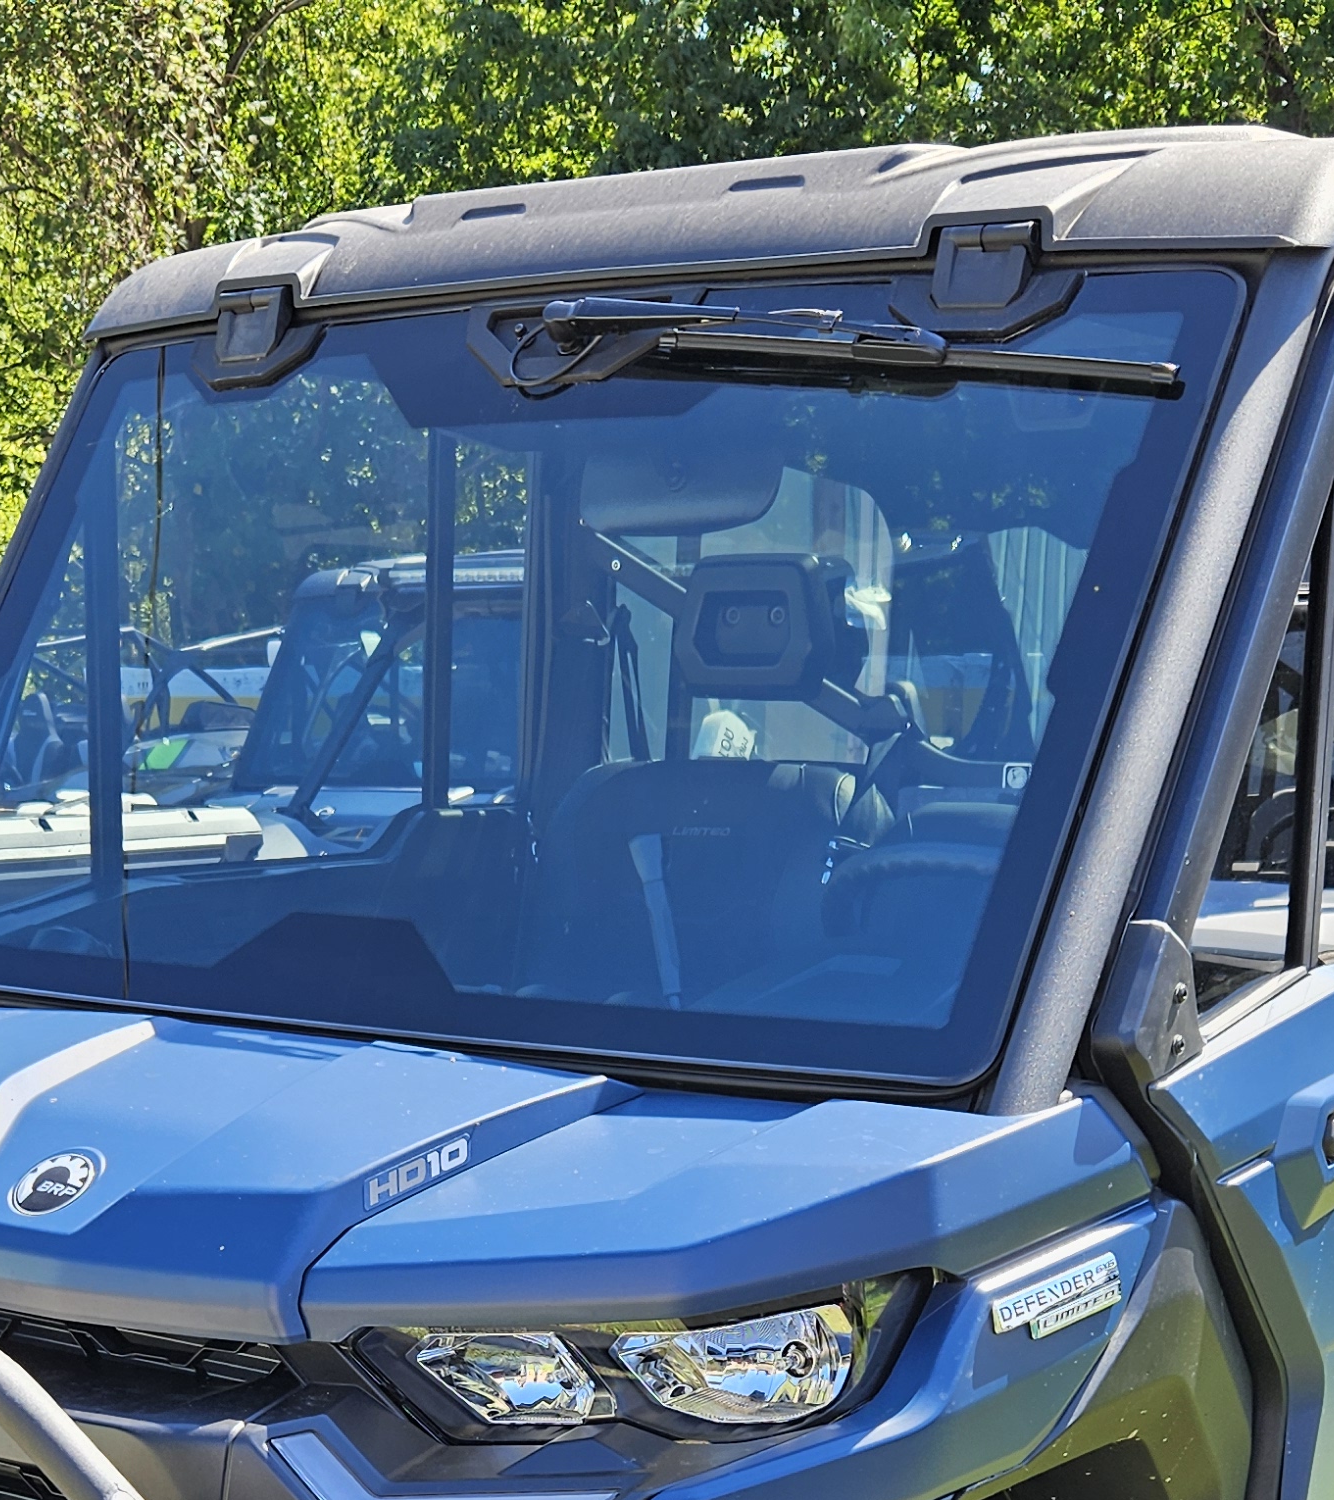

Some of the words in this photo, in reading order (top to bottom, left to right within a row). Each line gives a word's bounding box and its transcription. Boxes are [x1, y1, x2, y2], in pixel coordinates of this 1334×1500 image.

[672, 826, 731, 837] LIMITED
[36, 1180, 77, 1197] BRP
[369, 1138, 468, 1206] HD10
[998, 1269, 1096, 1323] DEFENDER
[1042, 1289, 1116, 1329] LIMITED
